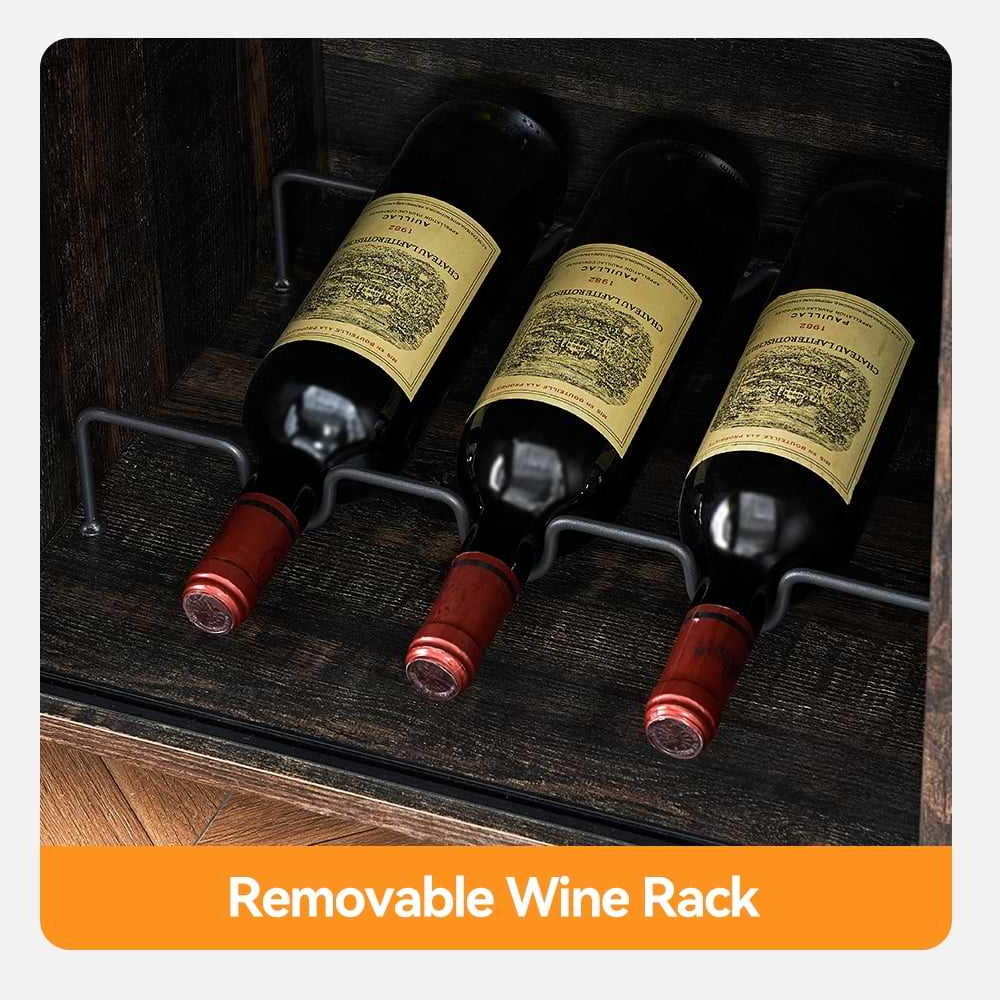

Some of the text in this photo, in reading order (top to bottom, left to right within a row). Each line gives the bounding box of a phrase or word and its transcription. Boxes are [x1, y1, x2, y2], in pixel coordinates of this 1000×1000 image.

[382, 214, 431, 228] AUILLAC
[388, 224, 413, 235] 1982
[418, 248, 460, 281] CHATEAU
[580, 265, 639, 283] PAUILLAC
[588, 276, 614, 287] 1982
[620, 301, 664, 333] CHATEAU
[790, 312, 851, 326] PAUILLAC
[835, 344, 879, 376] CHATEAU
[763, 434, 807, 451] BOUTEILLE
[819, 455, 832, 467] MIS
